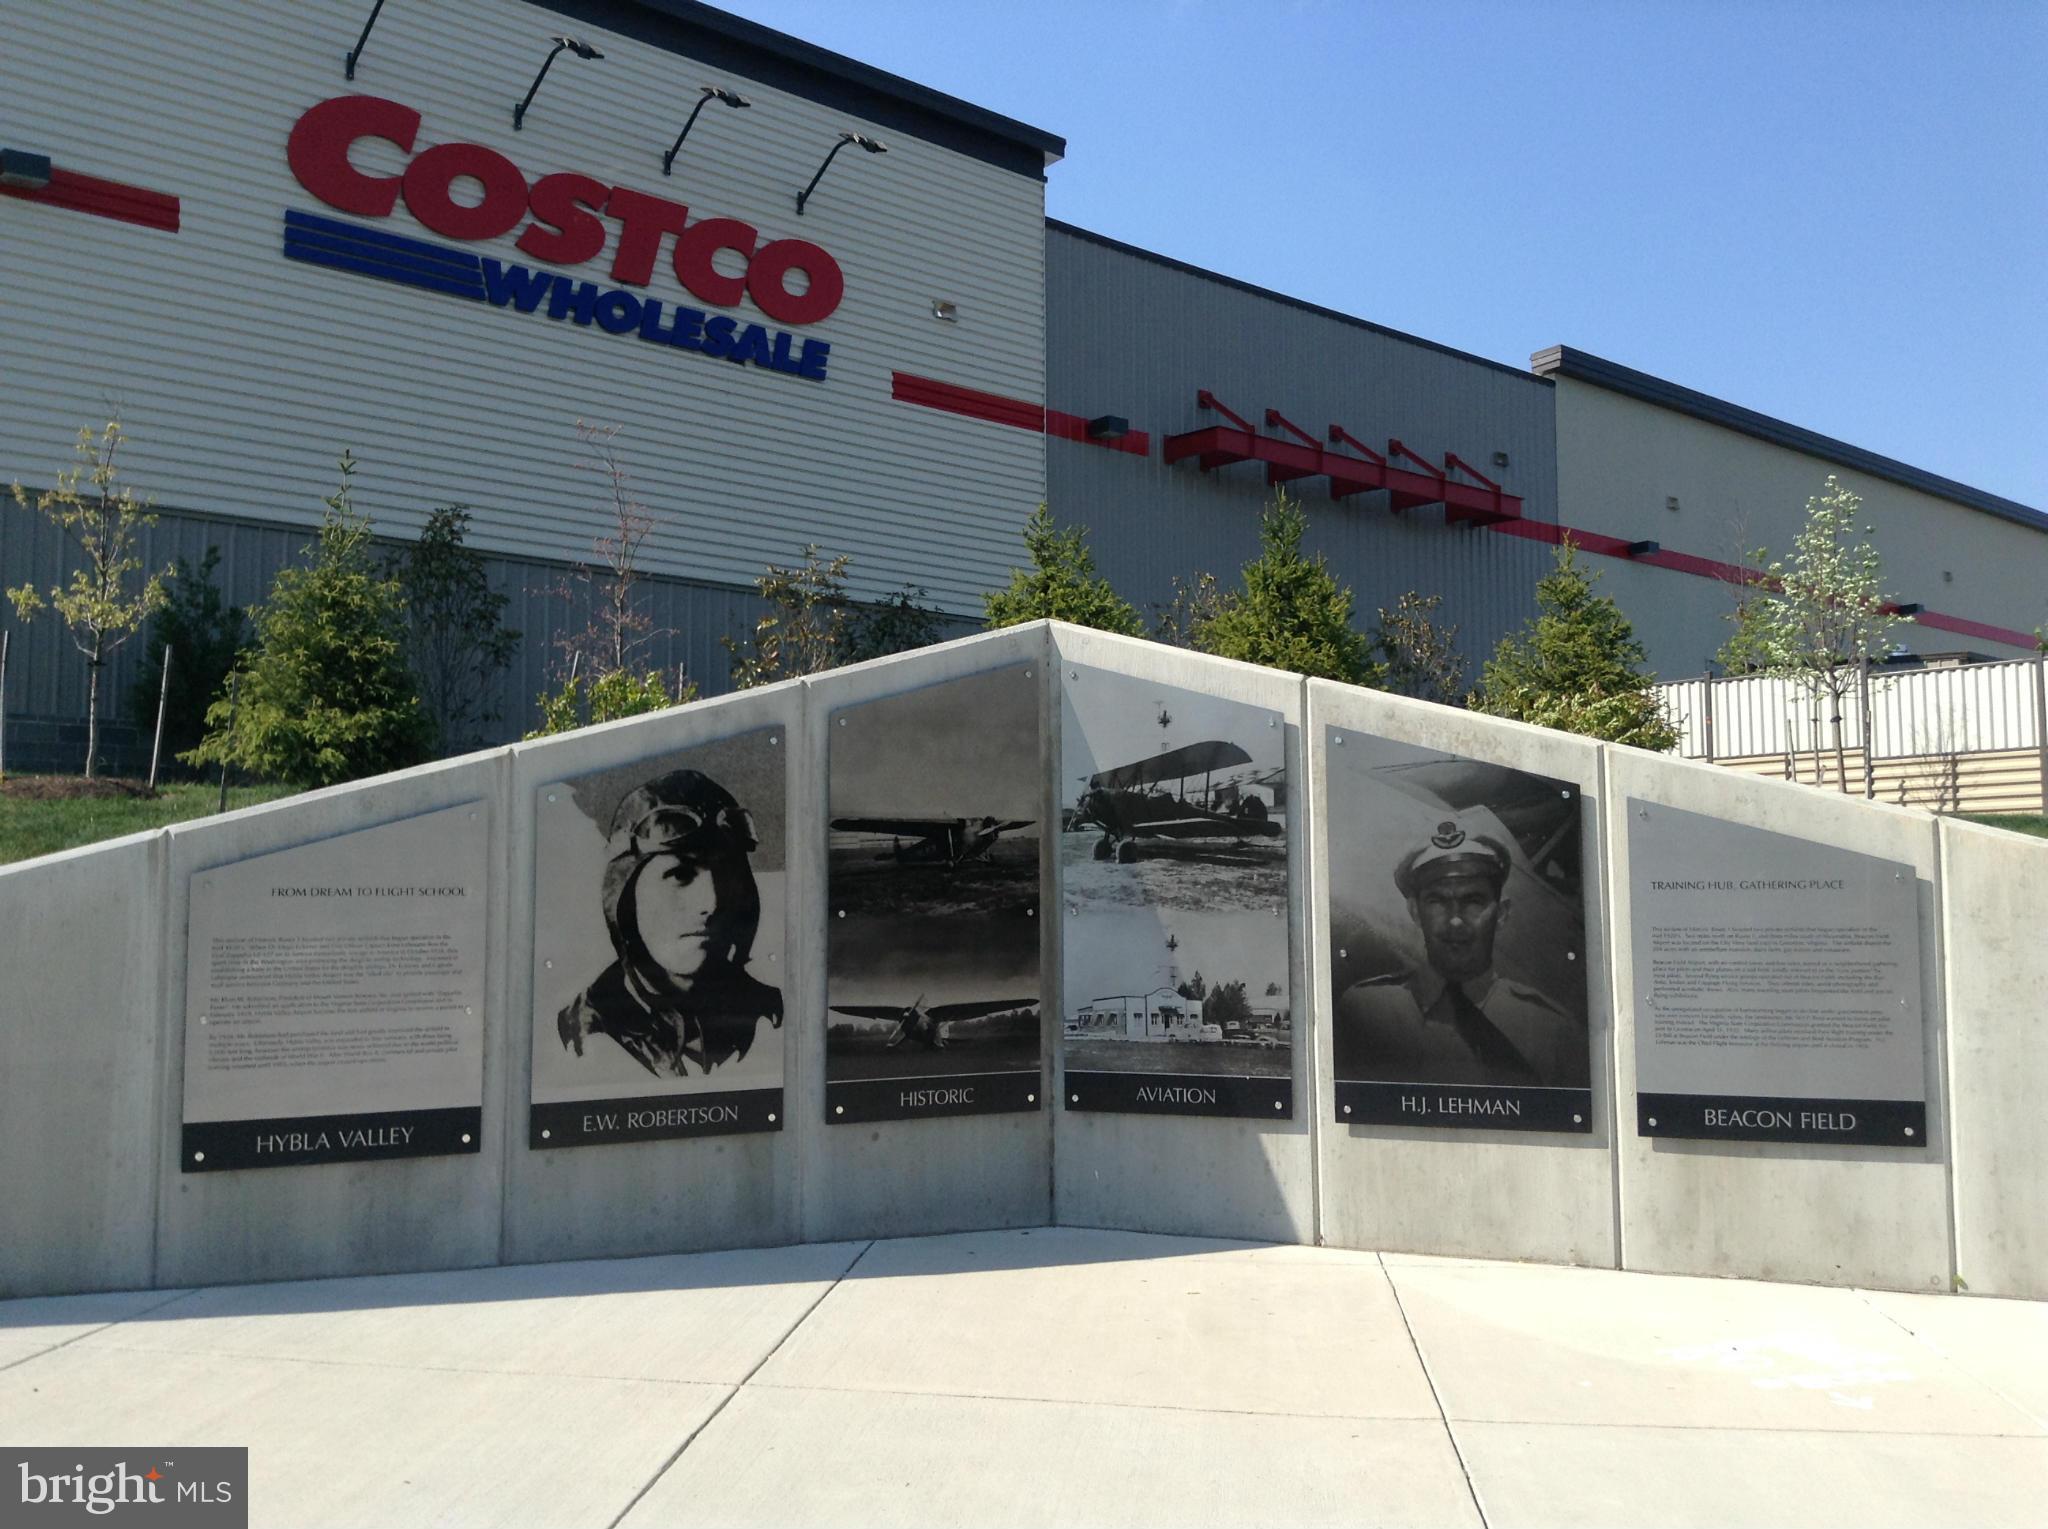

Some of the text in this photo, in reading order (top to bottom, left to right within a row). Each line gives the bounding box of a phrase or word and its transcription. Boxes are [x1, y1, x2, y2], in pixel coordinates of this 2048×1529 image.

[287, 94, 844, 325] COSTCO
[481, 257, 831, 382] WHOLESALE
[271, 887, 467, 897] FROM DREAM TO FLIGHT SCHOOL
[1651, 880, 1705, 891] TRAINING
[1739, 880, 1807, 891] GATHERING
[1809, 879, 1845, 890] PLACE
[900, 1087, 975, 1108] HISTORIC
[1136, 1086, 1217, 1105] AVIATION
[1401, 1095, 1521, 1117] H.J. LEHMAN
[583, 1104, 740, 1133] E.W. ROBERTSON
[1704, 1108, 1857, 1131] BEACON FIELD
[256, 1126, 415, 1154] HYBLA VALLEY
